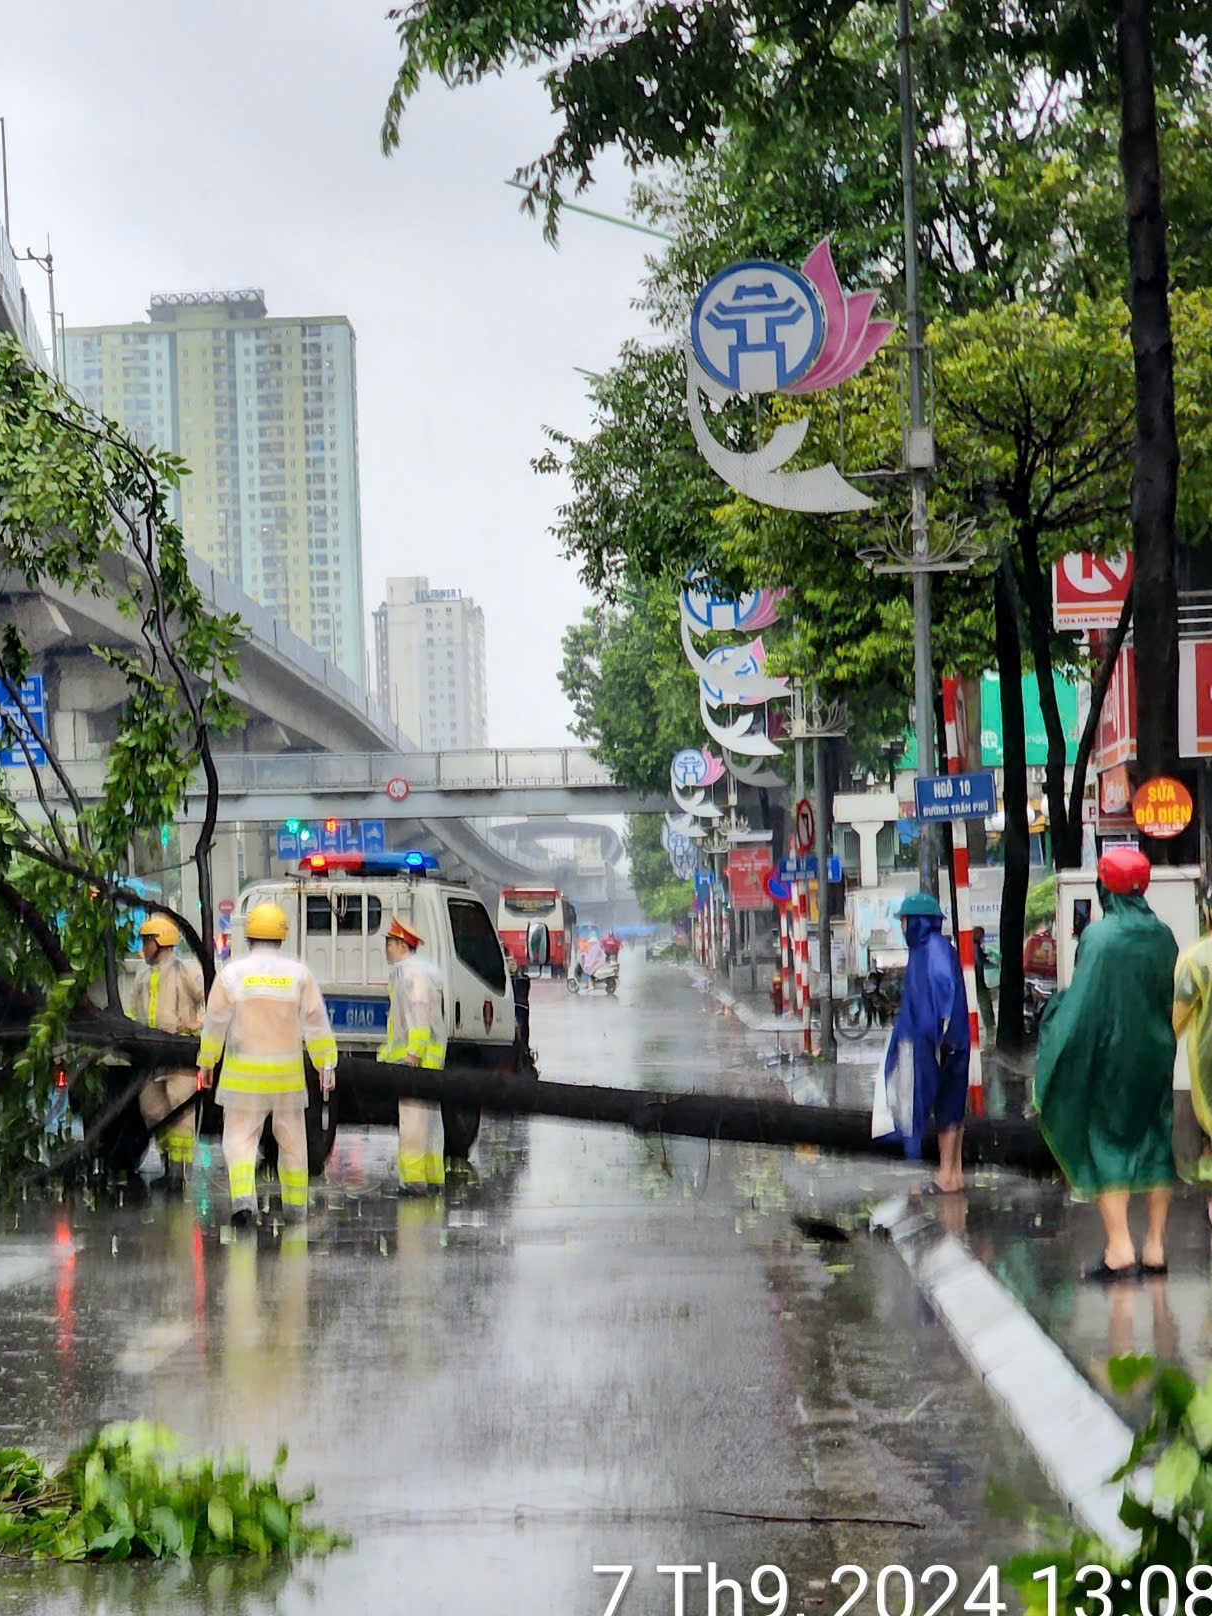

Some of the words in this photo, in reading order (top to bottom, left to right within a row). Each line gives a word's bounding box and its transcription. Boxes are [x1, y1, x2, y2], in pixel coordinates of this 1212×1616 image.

[959, 780, 971, 797] 10
[1148, 779, 1176, 802] SỬA
[1135, 802, 1155, 825] ĐỒ
[346, 1008, 375, 1025] GIAO
